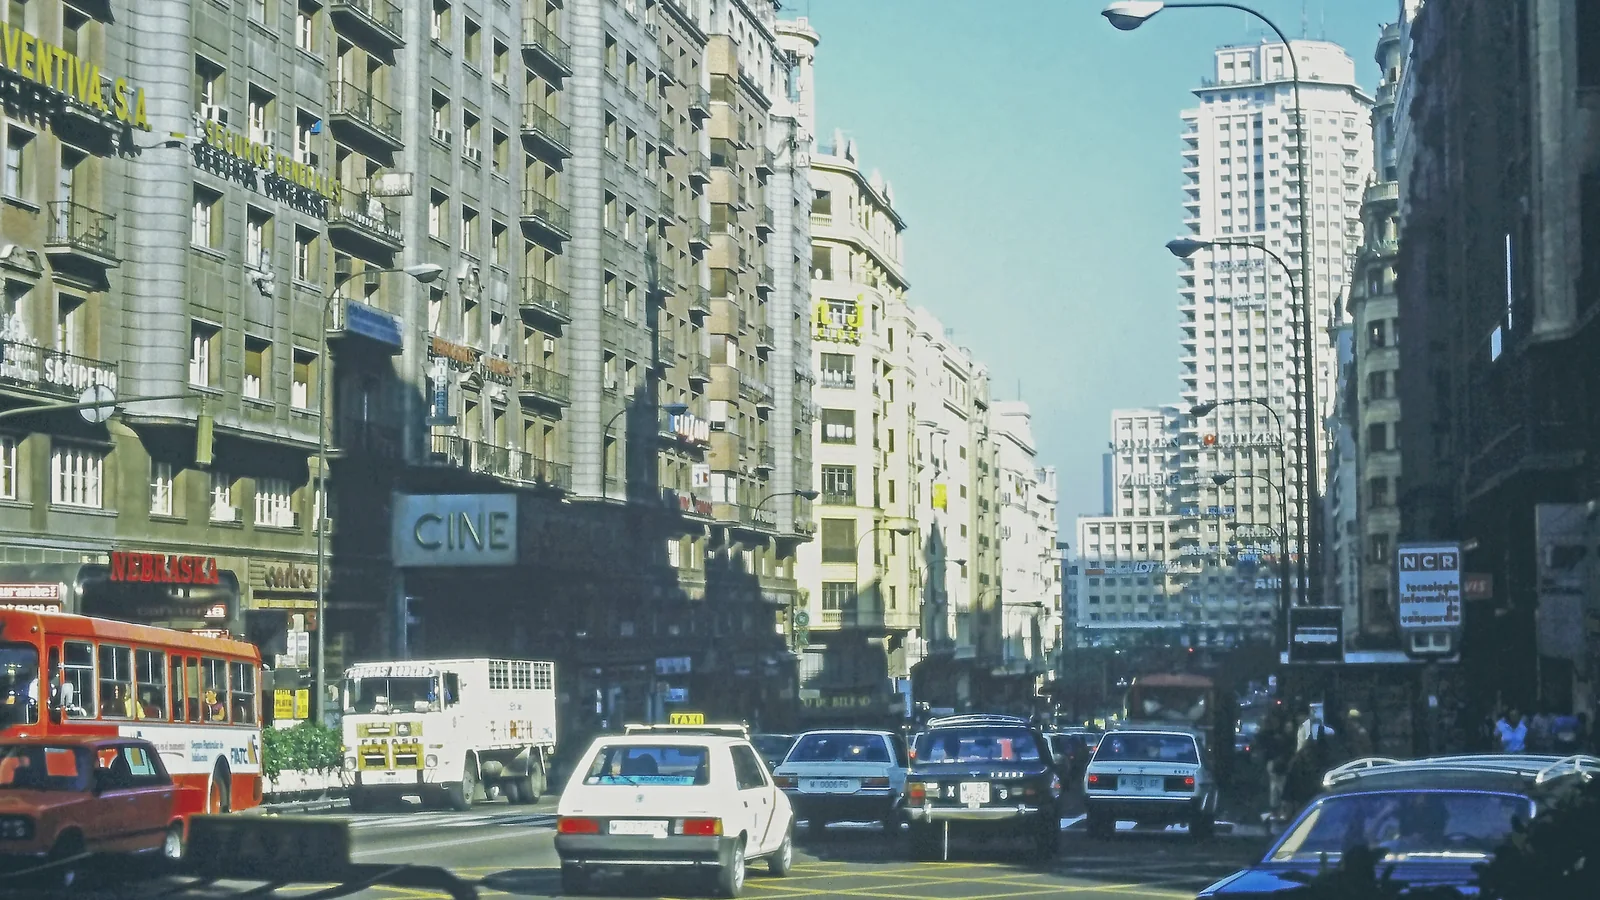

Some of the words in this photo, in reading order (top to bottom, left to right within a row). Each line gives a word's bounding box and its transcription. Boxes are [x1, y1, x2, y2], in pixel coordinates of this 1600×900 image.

[206, 119, 270, 170] SEGUROS
[276, 152, 341, 206] GENERALES
[1219, 433, 1284, 445] CITIZEN
[414, 511, 509, 550] CINE
[111, 552, 219, 584] NEBRASKA
[1403, 556, 1454, 569] NCR
[1464, 580, 1487, 593] VIS
[672, 715, 702, 725] TAXI
[361, 737, 419, 745] PEGASO
